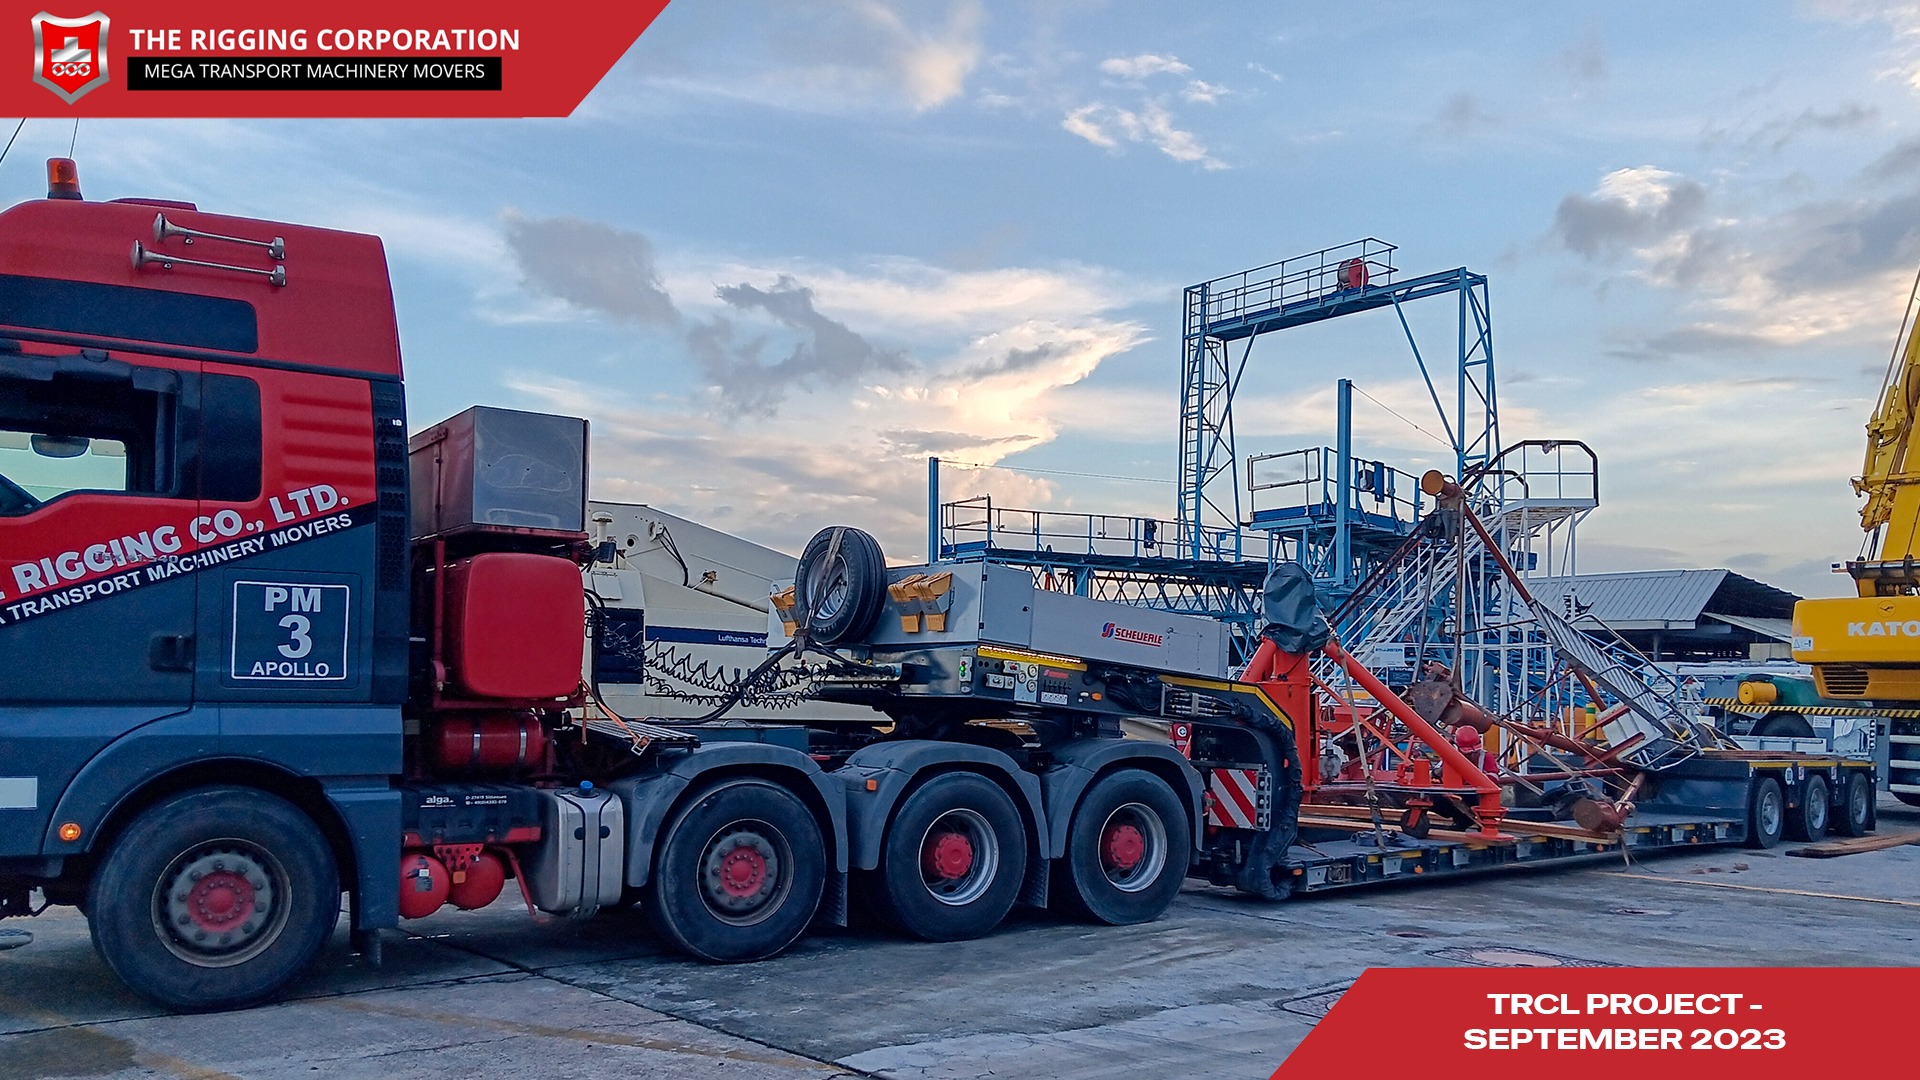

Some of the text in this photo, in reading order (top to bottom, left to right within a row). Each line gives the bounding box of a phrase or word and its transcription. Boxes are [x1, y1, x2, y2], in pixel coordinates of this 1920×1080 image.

[12, 484, 349, 594] RIGGING CO., LTD.
[6, 513, 352, 620] TRANSPORT MACHINERY MOVERS
[265, 587, 321, 612] PM
[277, 614, 312, 659] 3
[718, 634, 749, 643] Lufthansa
[1114, 627, 1163, 645] SCHEUERLE
[1848, 621, 1920, 637] KATO
[250, 660, 330, 678] APOLLO
